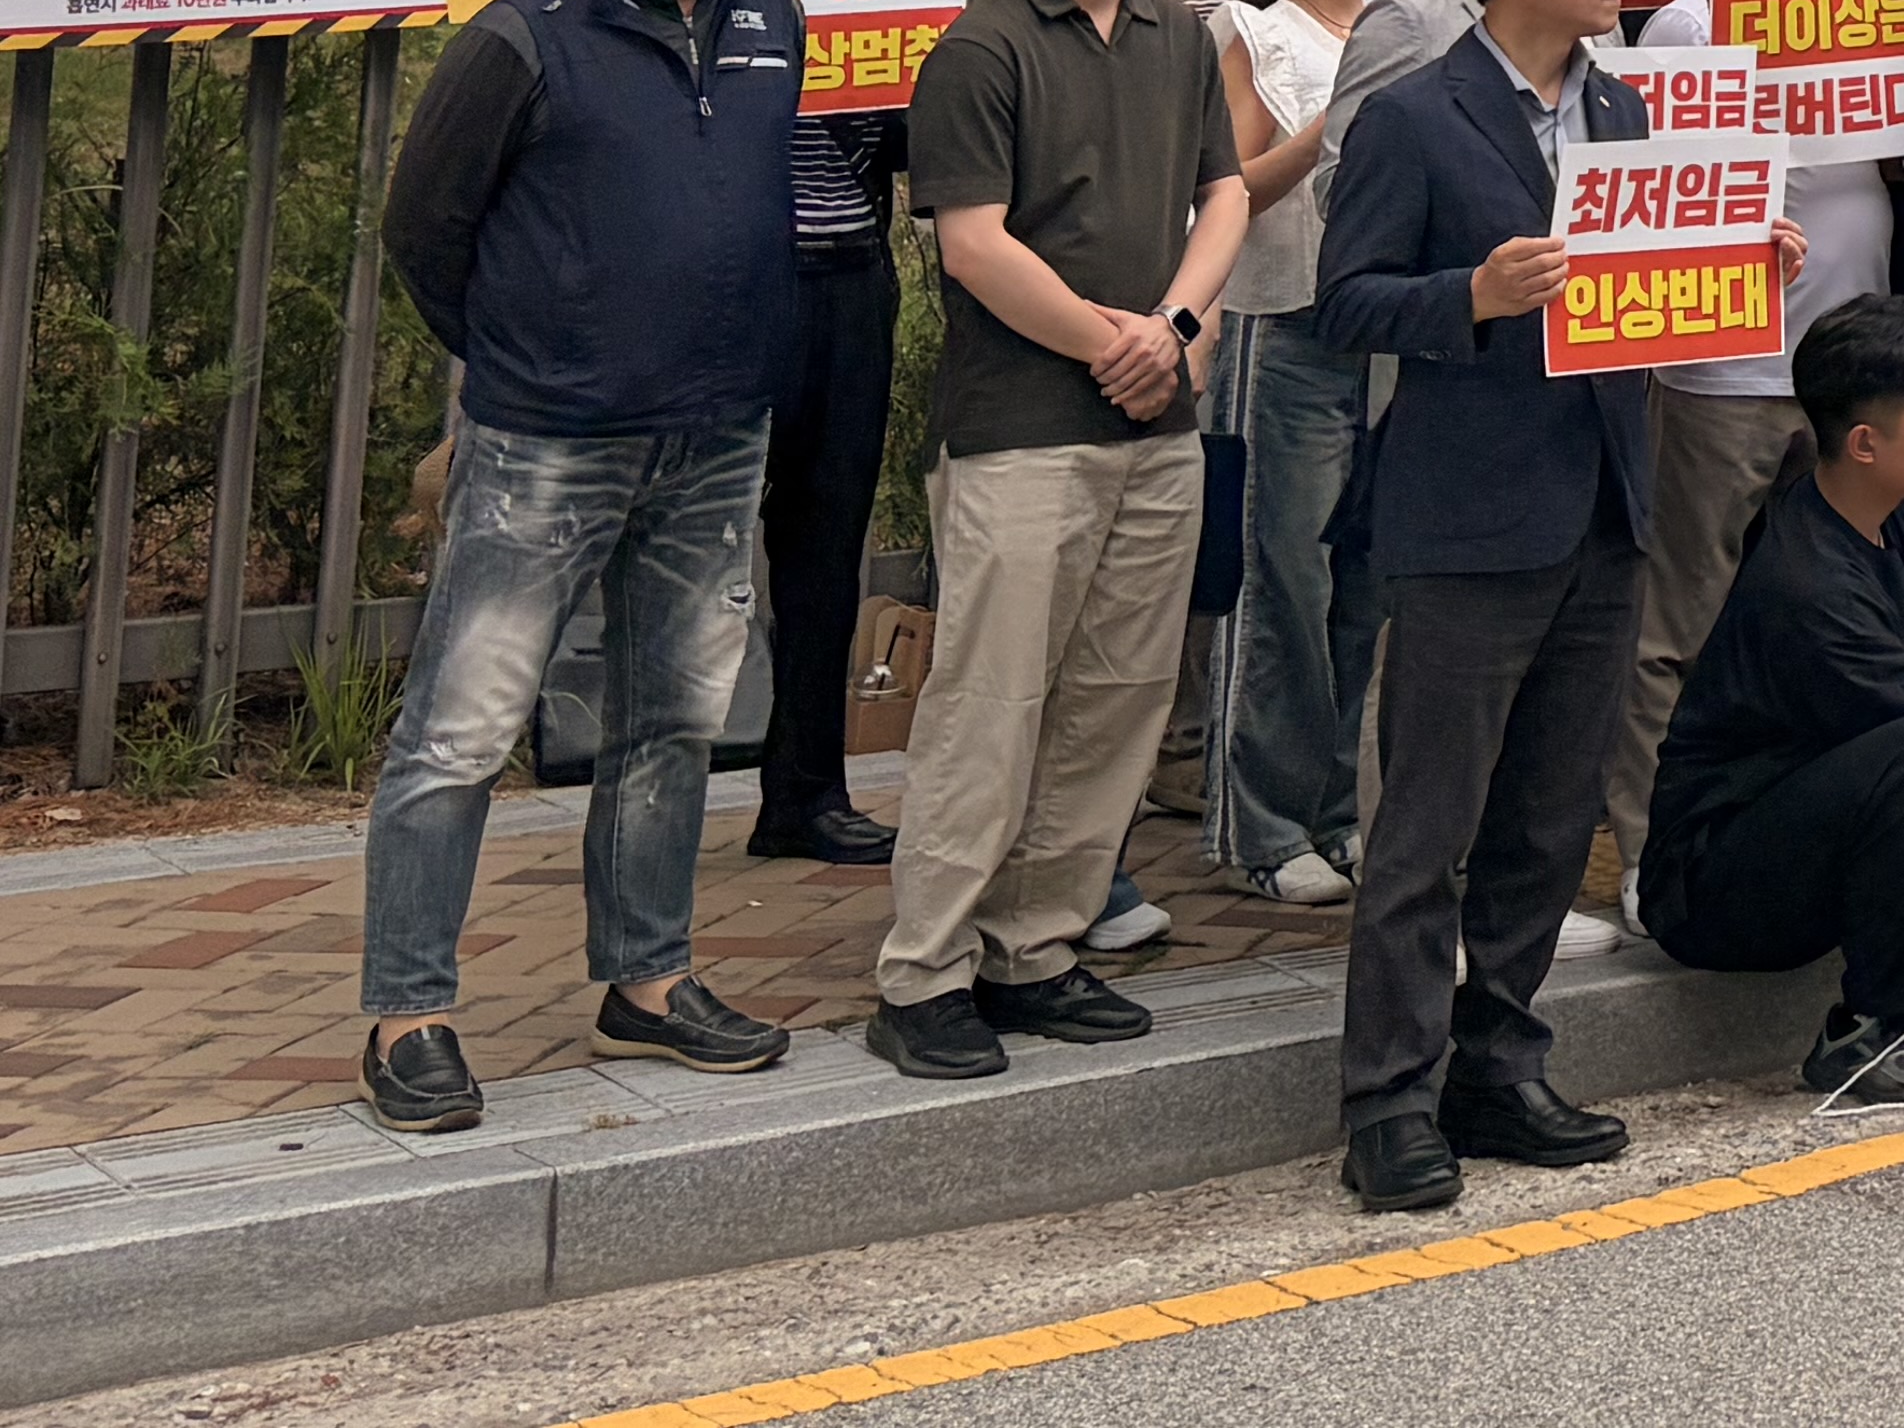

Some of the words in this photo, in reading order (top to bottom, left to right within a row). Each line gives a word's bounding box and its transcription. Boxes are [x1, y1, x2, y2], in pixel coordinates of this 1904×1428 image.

[1618, 70, 1747, 131] 저임금
[1568, 160, 1772, 236] 최저임금
[1565, 262, 1769, 344] 인상반대
